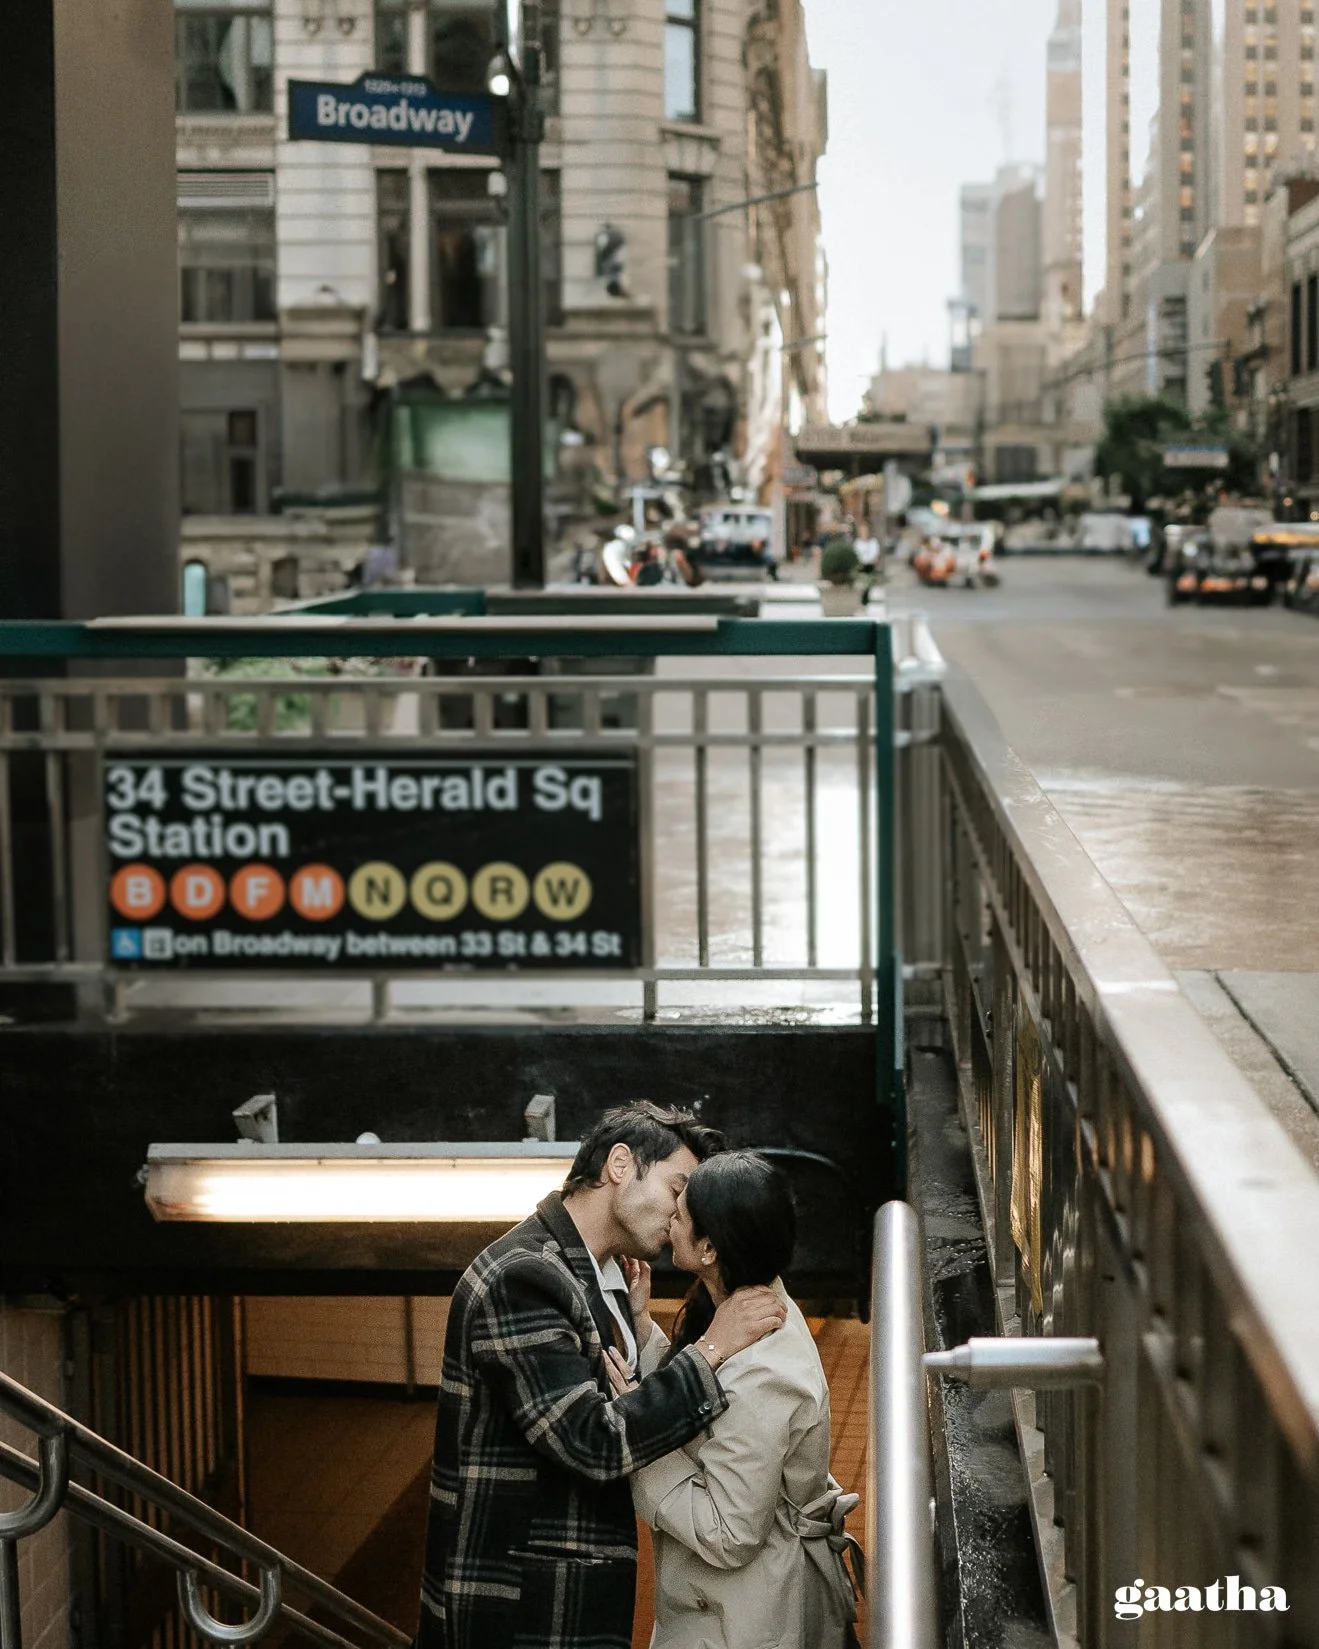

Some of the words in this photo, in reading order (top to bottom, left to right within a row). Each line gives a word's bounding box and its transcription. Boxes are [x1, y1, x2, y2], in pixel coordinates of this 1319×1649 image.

[316, 94, 475, 143] Broadway
[107, 766, 168, 810] 34
[181, 766, 518, 810] Street-Herald
[532, 766, 603, 821] Sq
[108, 813, 290, 857] Station
[125, 874, 153, 907] B
[184, 874, 214, 907] D
[244, 876, 272, 908] F
[301, 876, 334, 909] M
[364, 874, 391, 907] N
[424, 873, 454, 907] Q
[488, 874, 515, 906] R
[543, 876, 581, 908] W
[173, 934, 209, 955] on
[212, 929, 342, 962] Broadway
[345, 930, 457, 956] between
[460, 931, 493, 956] 33
[497, 931, 527, 956] St
[555, 931, 588, 956] 34
[591, 931, 623, 956] St
